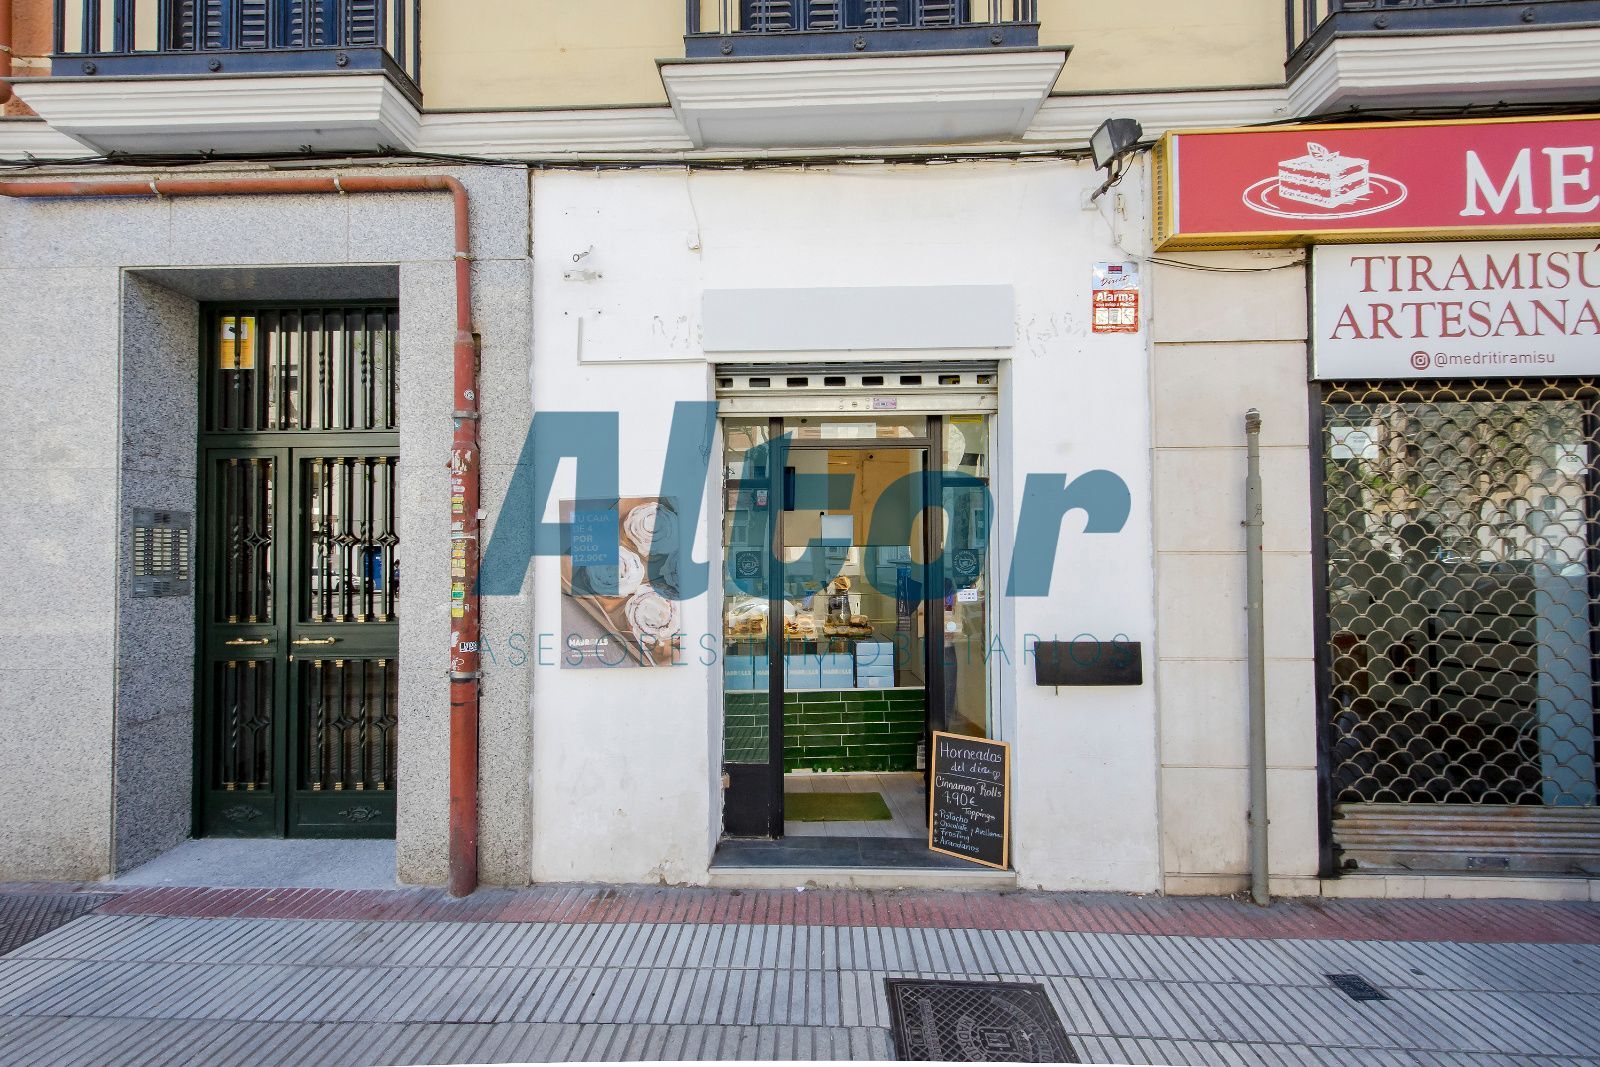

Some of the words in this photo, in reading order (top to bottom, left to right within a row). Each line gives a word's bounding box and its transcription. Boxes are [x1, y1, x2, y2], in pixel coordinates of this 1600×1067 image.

[1459, 146, 1600, 216] ME
[1096, 291, 1135, 302] Alarma
[1329, 299, 1600, 340] ARTESANA
[1434, 351, 1555, 368] @medritiramisu
[573, 535, 593, 543] POR
[940, 741, 1002, 763] Horneados
[950, 761, 965, 773] del
[935, 775, 976, 794] Cinnamon
[976, 781, 1002, 798] Rolls
[939, 808, 969, 824] Pistacho
[939, 827, 970, 844] Frosting
